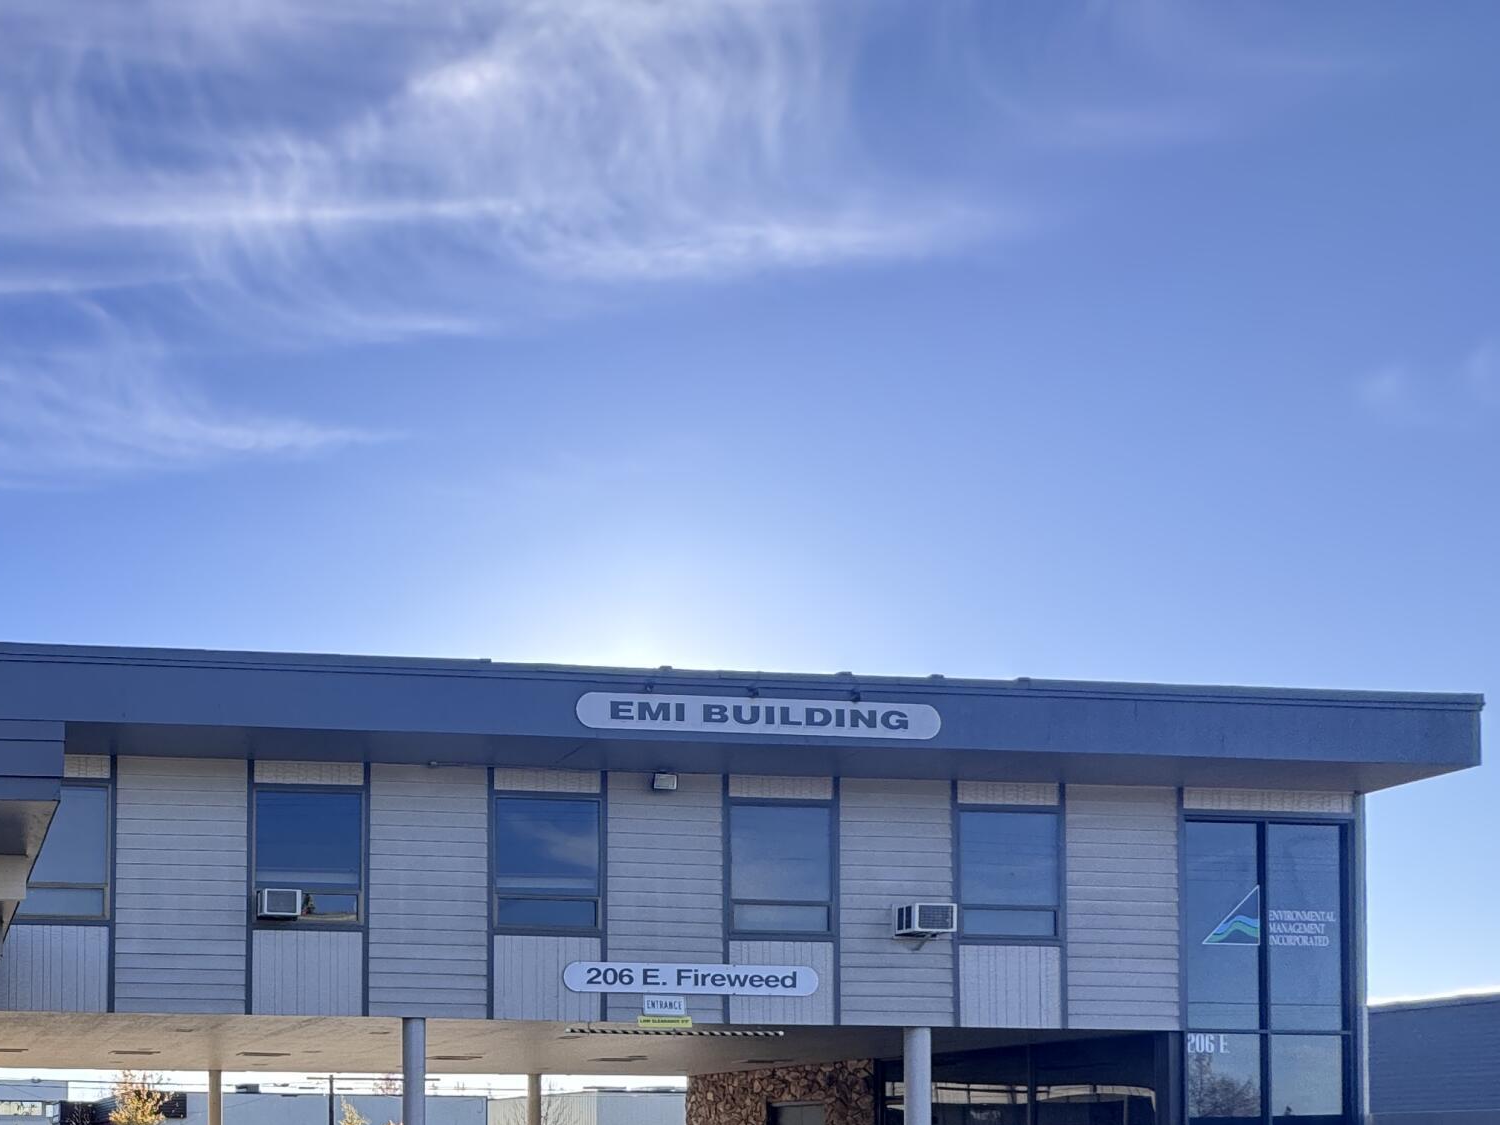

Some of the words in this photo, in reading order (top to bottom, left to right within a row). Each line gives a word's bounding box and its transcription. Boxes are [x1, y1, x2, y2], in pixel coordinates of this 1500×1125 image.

[610, 700, 685, 721] EMI
[702, 703, 909, 730] BUILDING
[1268, 910, 1336, 922] ENVIRONMENTAL
[1268, 922, 1326, 934] MANAGEMENT
[1268, 935, 1330, 947] INCORPORATED
[586, 967, 634, 985] 206
[642, 968, 667, 986] E.
[676, 969, 797, 988] Fireweed
[646, 1000, 683, 1010] ENTRANCE
[1187, 1033, 1214, 1053] 206
